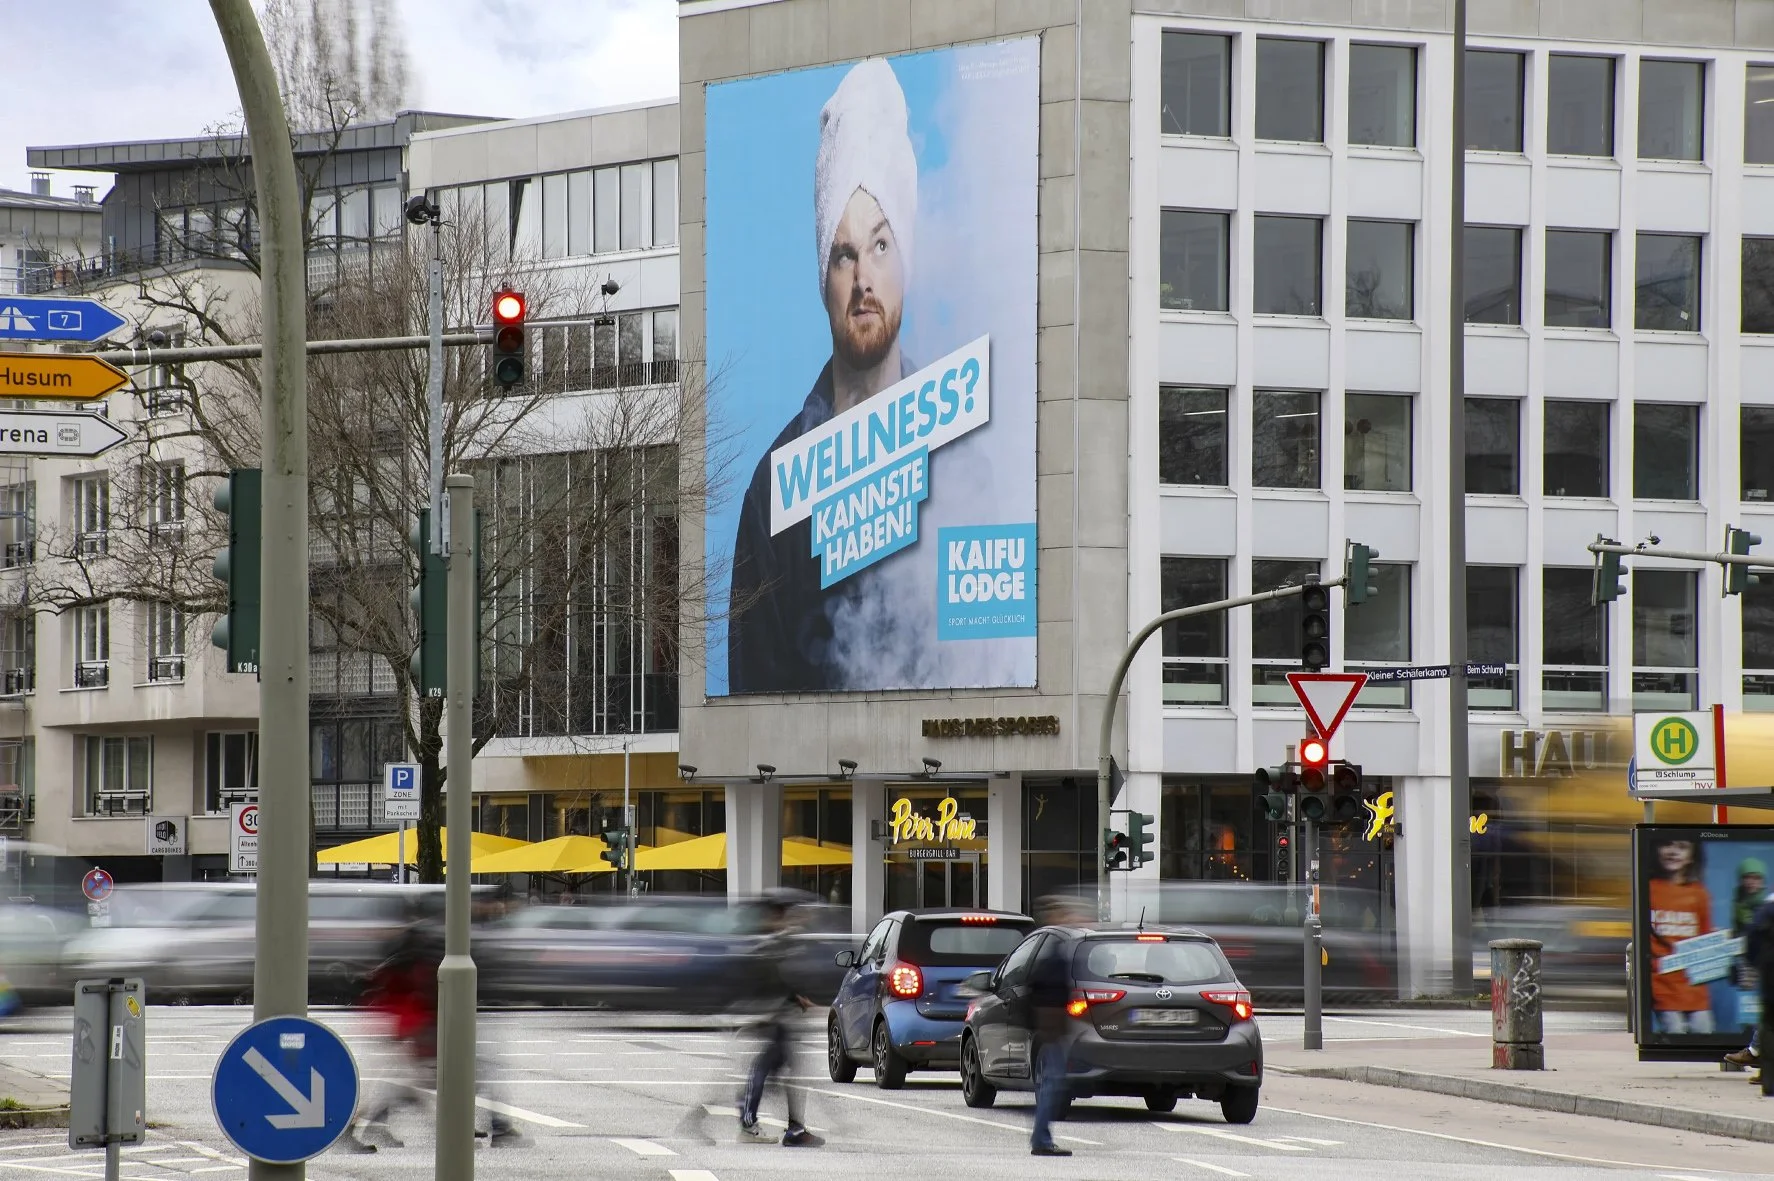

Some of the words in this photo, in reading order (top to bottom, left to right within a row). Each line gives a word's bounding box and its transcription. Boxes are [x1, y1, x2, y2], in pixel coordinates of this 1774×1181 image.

[60, 314, 69, 327] 7
[0, 367, 72, 387] Husum
[777, 357, 980, 511] WELLNESS?
[816, 456, 924, 543] KANNSTE
[826, 500, 912, 576] HABEN!
[948, 538, 1025, 571] KAIFU
[948, 572, 1025, 603] LODGE
[948, 617, 966, 626] SPORT
[1368, 671, 1394, 680] Kleiner
[1396, 668, 1448, 679] Schäferkamp
[1467, 666, 1480, 674] Beim
[1481, 665, 1504, 675] Schlump
[429, 687, 442, 697] K29
[1663, 728, 1686, 754] H
[1500, 729, 1614, 777] HAU
[1663, 770, 1696, 779] Schlump
[1694, 781, 1713, 789] hvv
[889, 798, 935, 845] Peter
[935, 797, 976, 843] Pane
